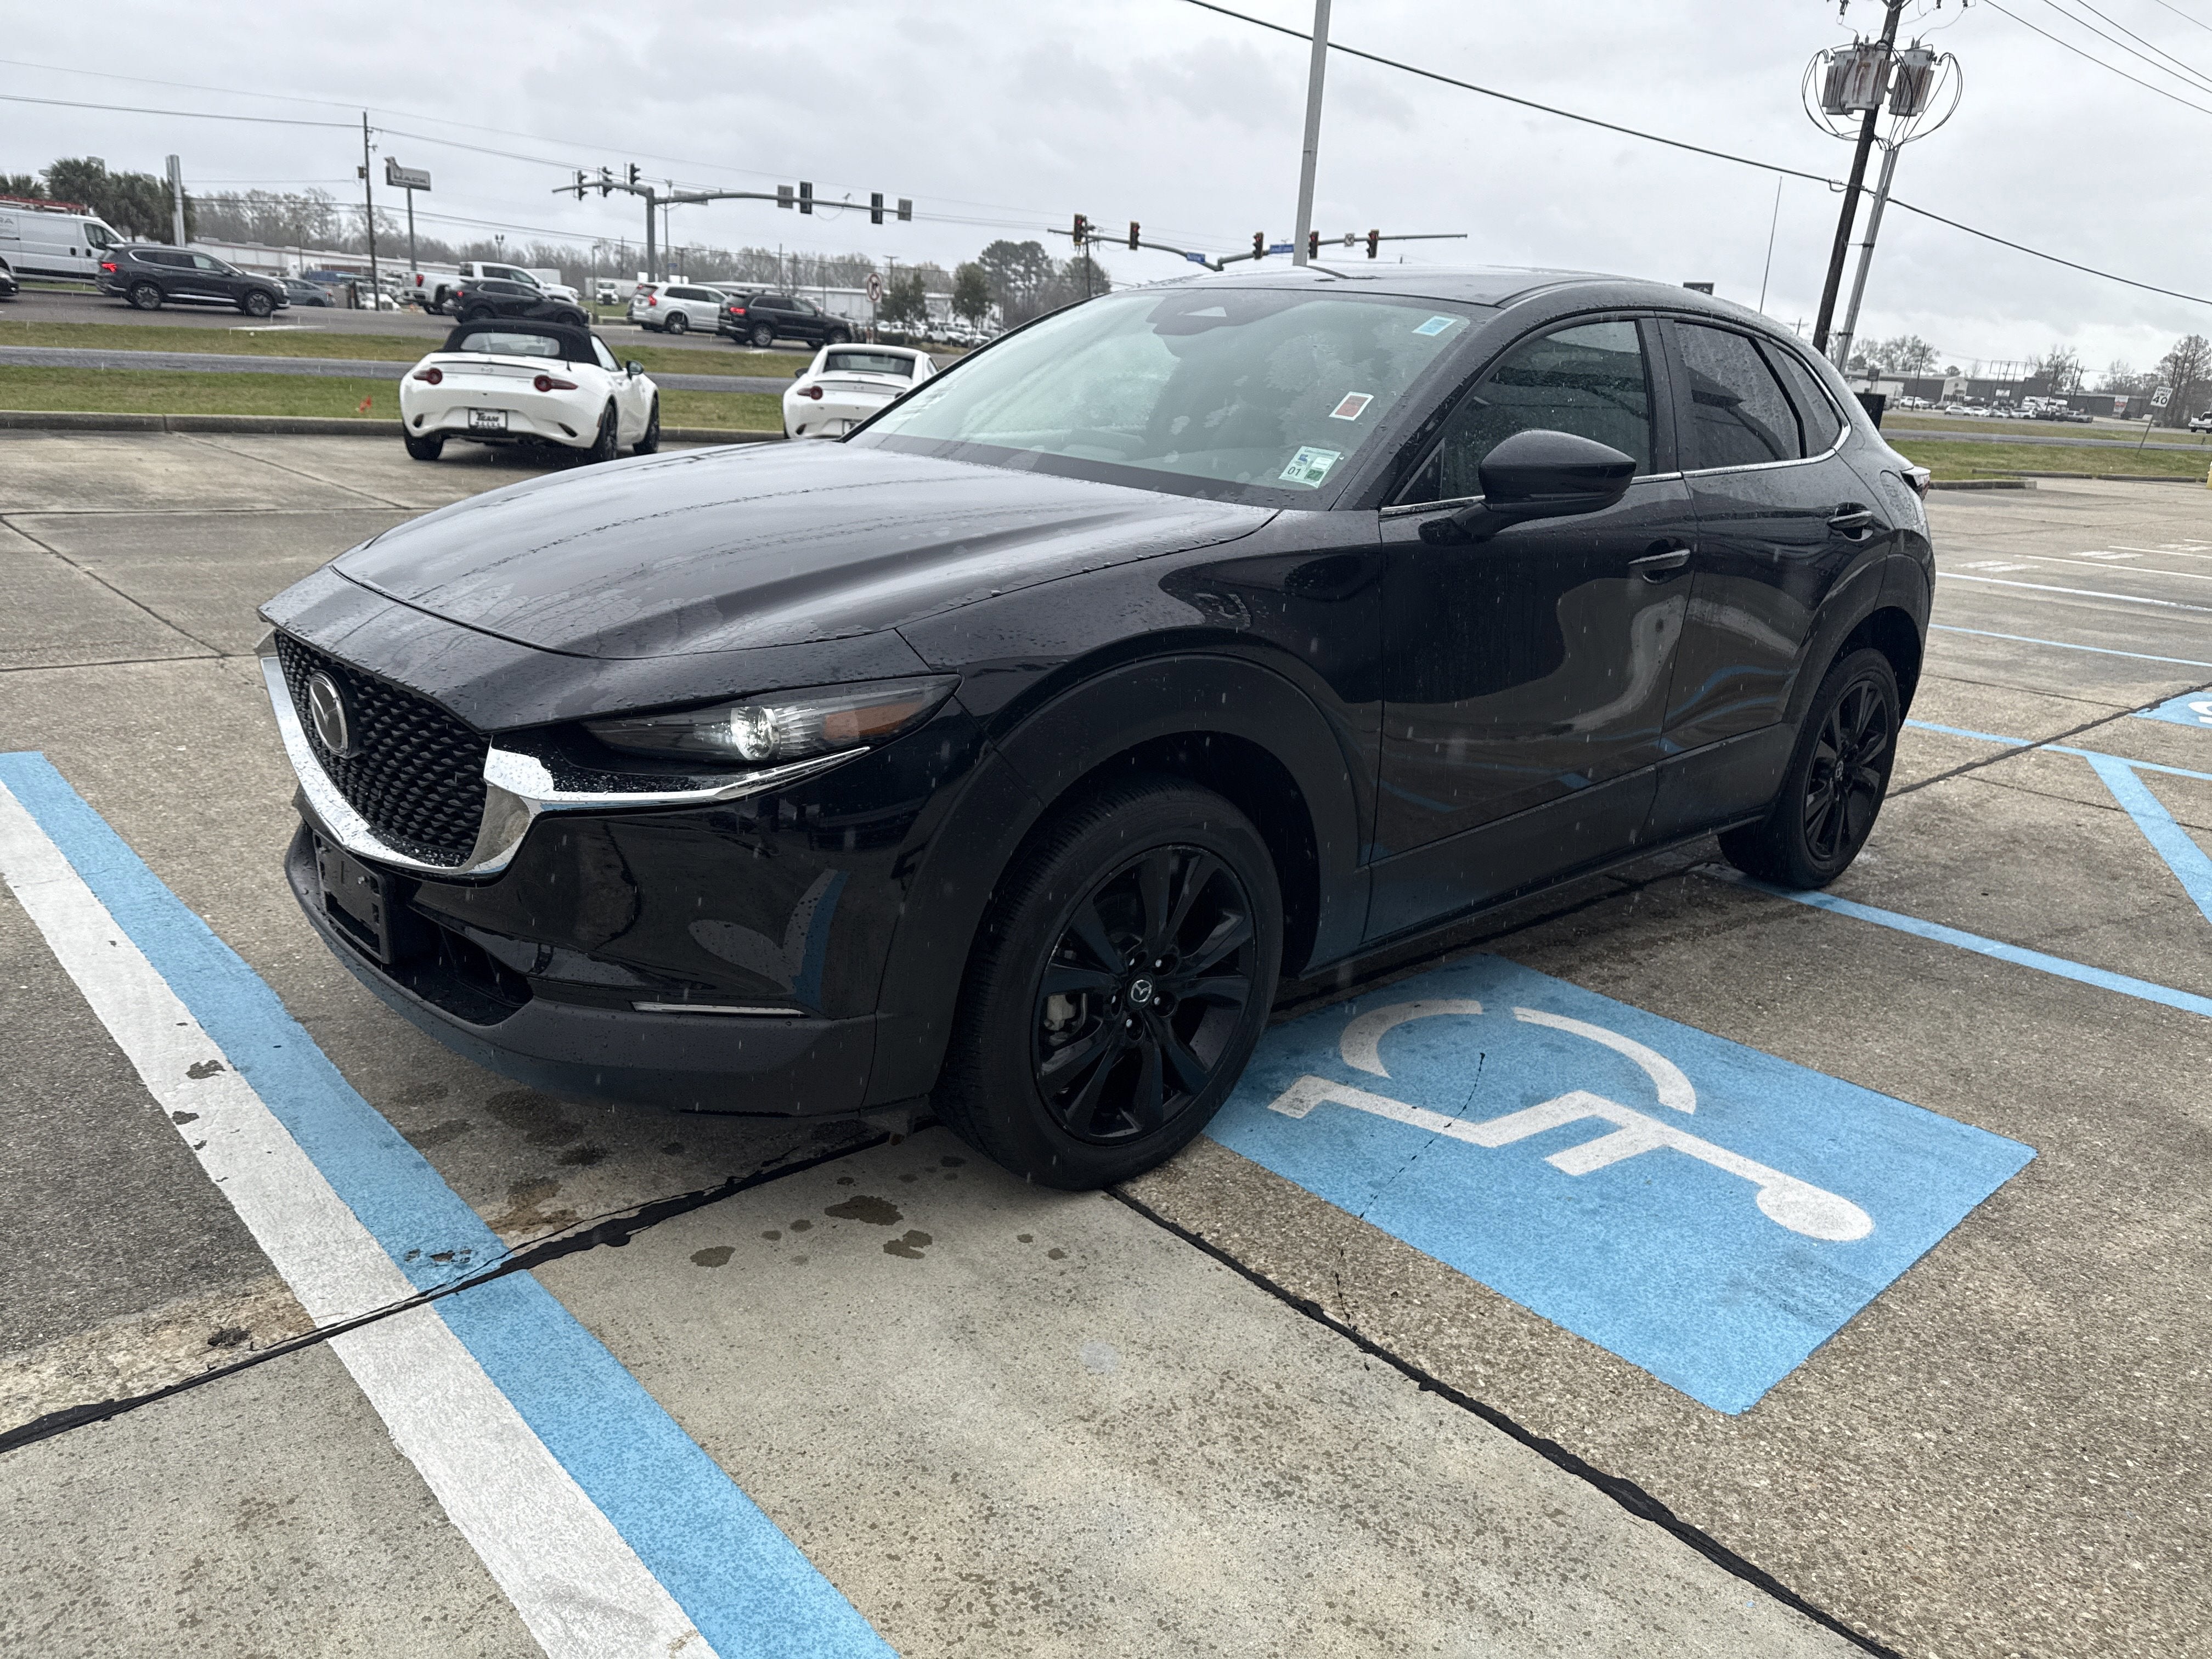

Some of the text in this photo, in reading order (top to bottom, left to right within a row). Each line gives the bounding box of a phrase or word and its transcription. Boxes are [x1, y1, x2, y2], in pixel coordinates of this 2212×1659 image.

[2153, 396, 2168, 404] 40
[1288, 467, 1324, 480] 01 27
